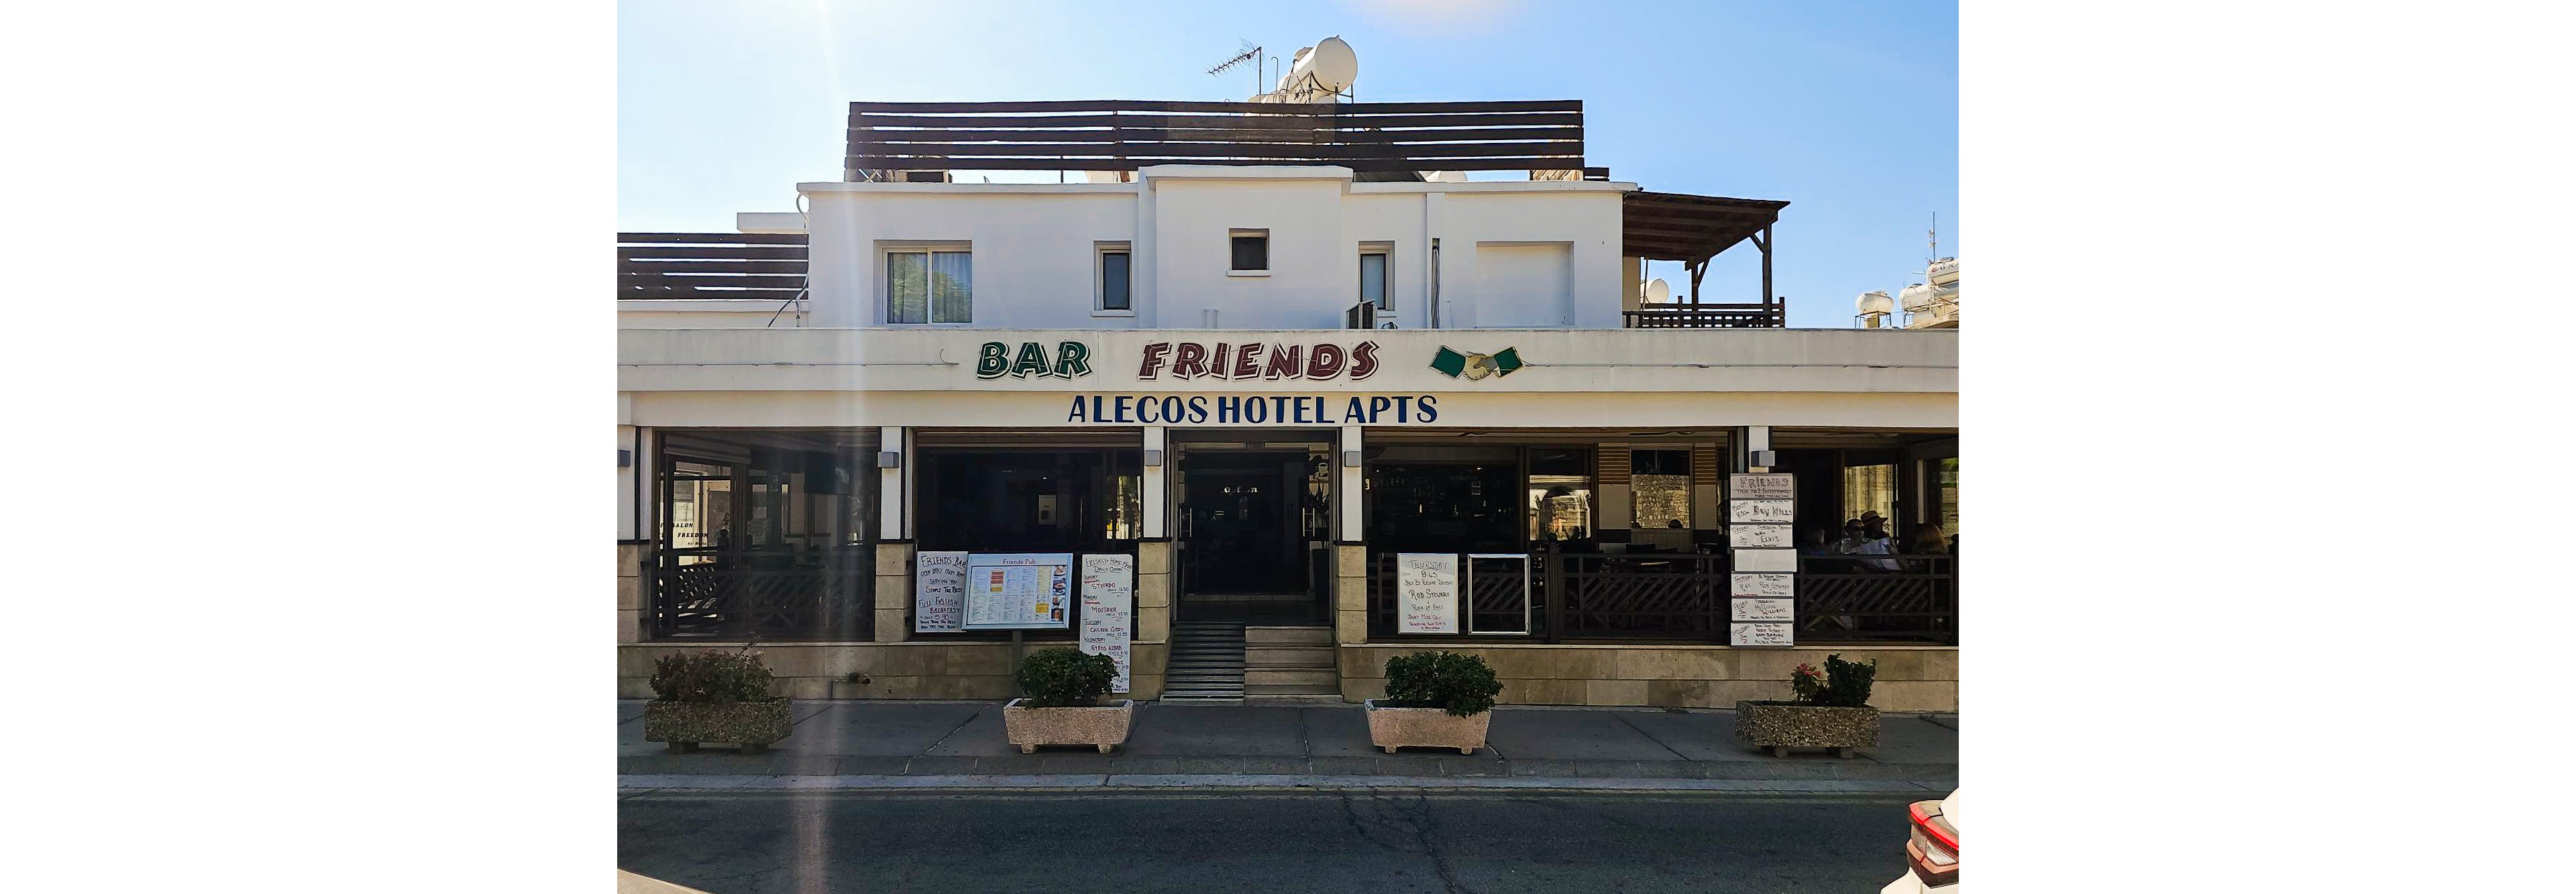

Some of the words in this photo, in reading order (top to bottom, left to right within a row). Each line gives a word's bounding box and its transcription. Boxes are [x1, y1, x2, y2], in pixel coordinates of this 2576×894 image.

[976, 341, 1093, 381] BAR
[1138, 340, 1381, 382] FRIENDS
[1068, 394, 1208, 424] ALECOS
[1218, 396, 1336, 424] HOTEL
[1344, 394, 1438, 424] APTS
[1740, 477, 1789, 488] FRIENDS
[920, 555, 952, 567] FRIENDS
[953, 557, 967, 568] BAR
[1409, 560, 1447, 569] THURSDAY
[1409, 590, 1425, 600] ROD
[1426, 589, 1450, 599] STEWART
[918, 600, 932, 608] FULL
[935, 596, 958, 606] ENGLISH
